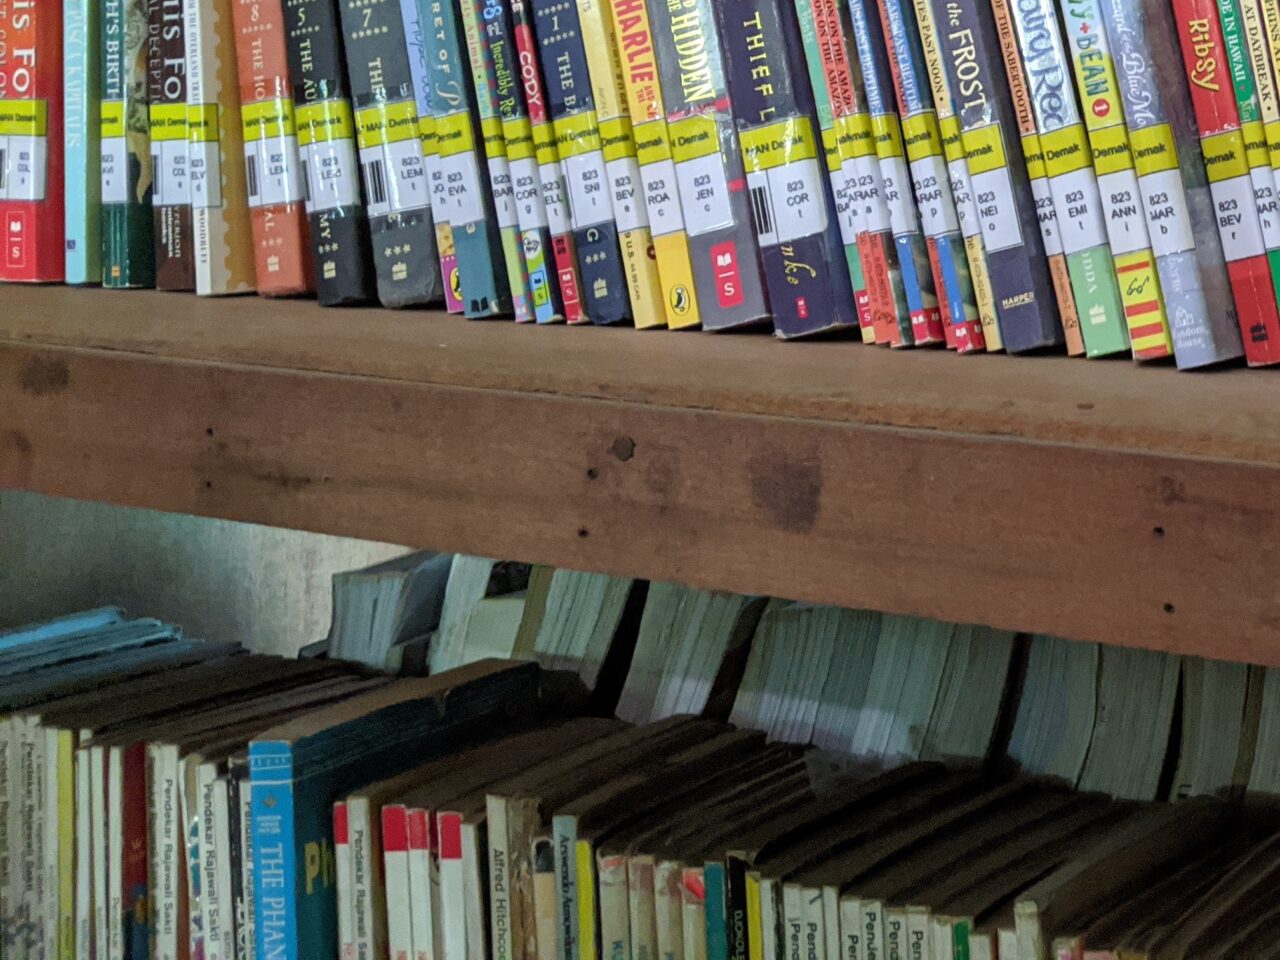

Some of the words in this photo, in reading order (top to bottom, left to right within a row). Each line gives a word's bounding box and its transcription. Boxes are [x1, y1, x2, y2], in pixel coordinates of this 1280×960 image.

[946, 0, 959, 27] the
[12, 46, 36, 98] FO
[164, 57, 186, 100] FO
[519, 51, 541, 106] CODY
[671, 9, 717, 104] HIDDEN
[743, 14, 776, 98] THIEF
[922, 27, 936, 55] PAST
[929, 58, 944, 93] NOON
[1188, 18, 1220, 92] Ribsy
[258, 841, 285, 890] THE
